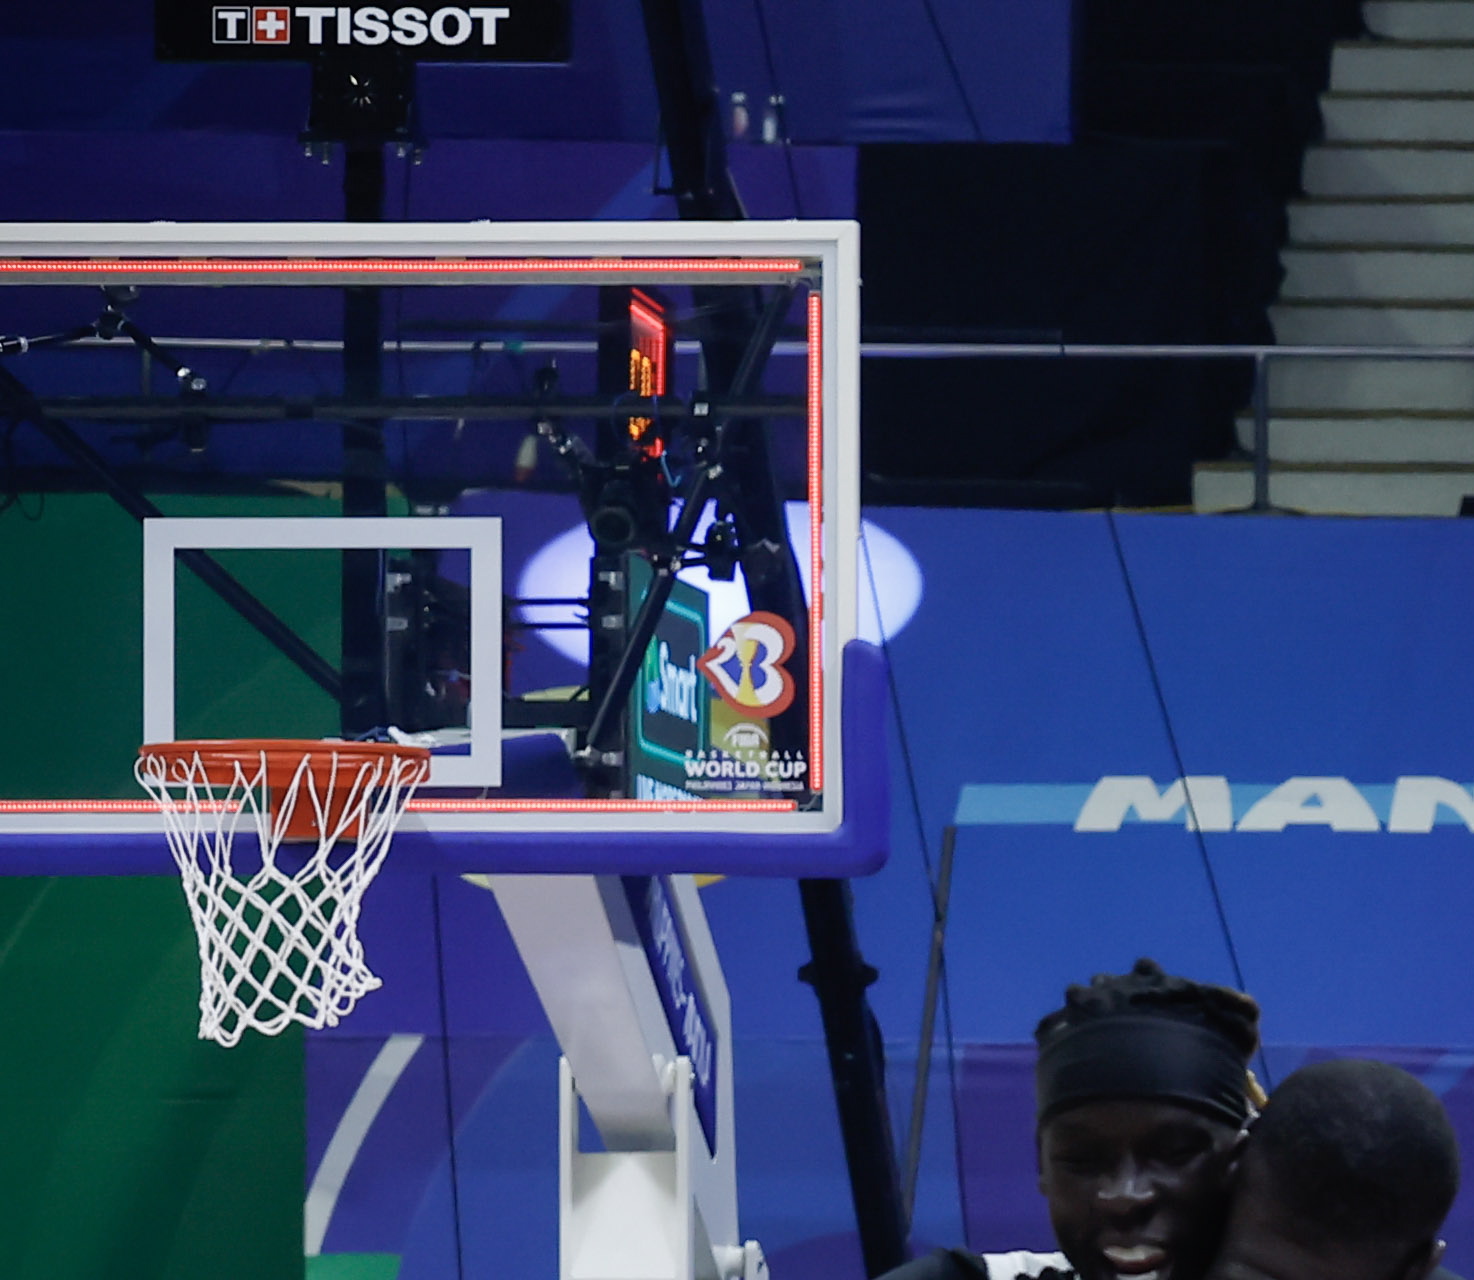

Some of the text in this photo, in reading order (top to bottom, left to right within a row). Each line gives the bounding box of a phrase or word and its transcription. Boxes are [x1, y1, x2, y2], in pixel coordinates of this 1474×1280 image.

[295, 7, 510, 46] TISSOT
[685, 760, 807, 778] WORLD CUP
